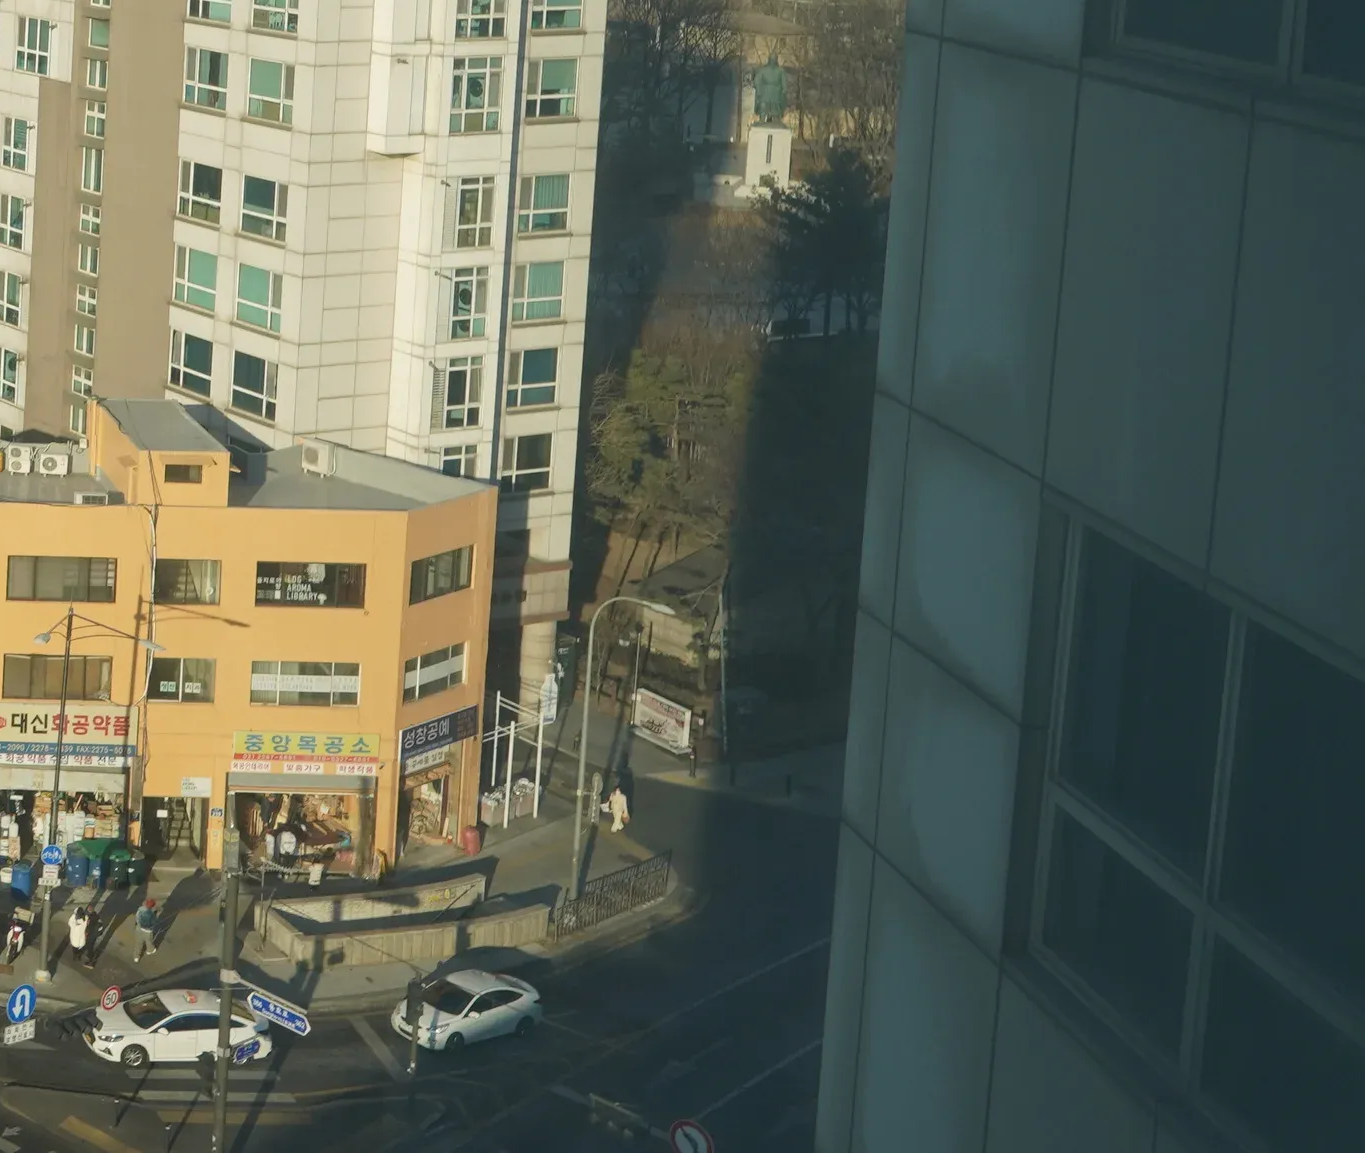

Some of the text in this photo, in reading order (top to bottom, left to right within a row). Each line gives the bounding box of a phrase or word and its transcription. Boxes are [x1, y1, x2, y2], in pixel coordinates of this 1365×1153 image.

[286, 584, 312, 592] AROMA
[286, 592, 318, 601] LIBRARY
[11, 713, 130, 737] 대신화공약품
[403, 718, 450, 748] 성창공예
[243, 734, 371, 755] 중앙목공소
[286, 763, 321, 773] 맞춤가구
[105, 992, 117, 1006] 50
